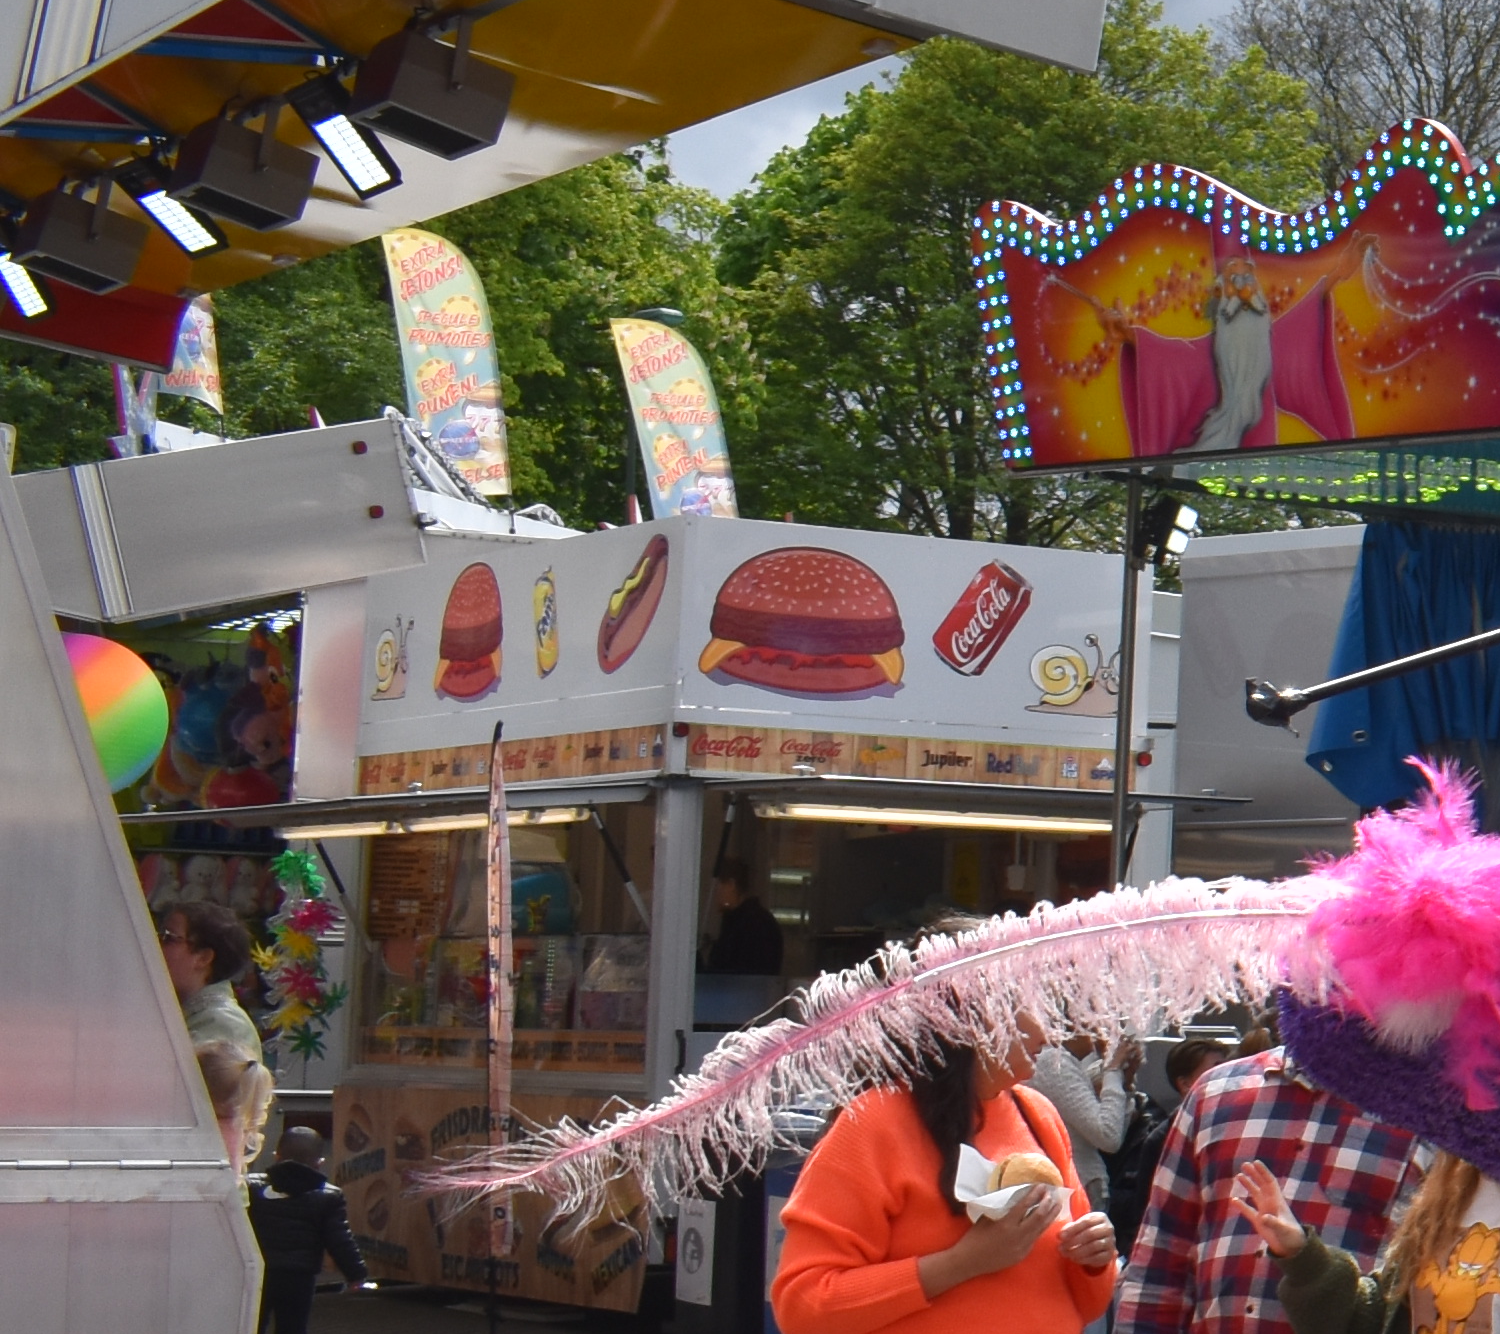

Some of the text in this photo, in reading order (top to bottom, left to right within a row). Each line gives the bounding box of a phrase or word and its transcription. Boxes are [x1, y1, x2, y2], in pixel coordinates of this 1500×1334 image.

[400, 240, 446, 272] EXTRA
[400, 255, 464, 301] JETONS!
[630, 332, 670, 357] EXTRA
[421, 362, 456, 394] EXTRA
[629, 343, 687, 383] JETONS!
